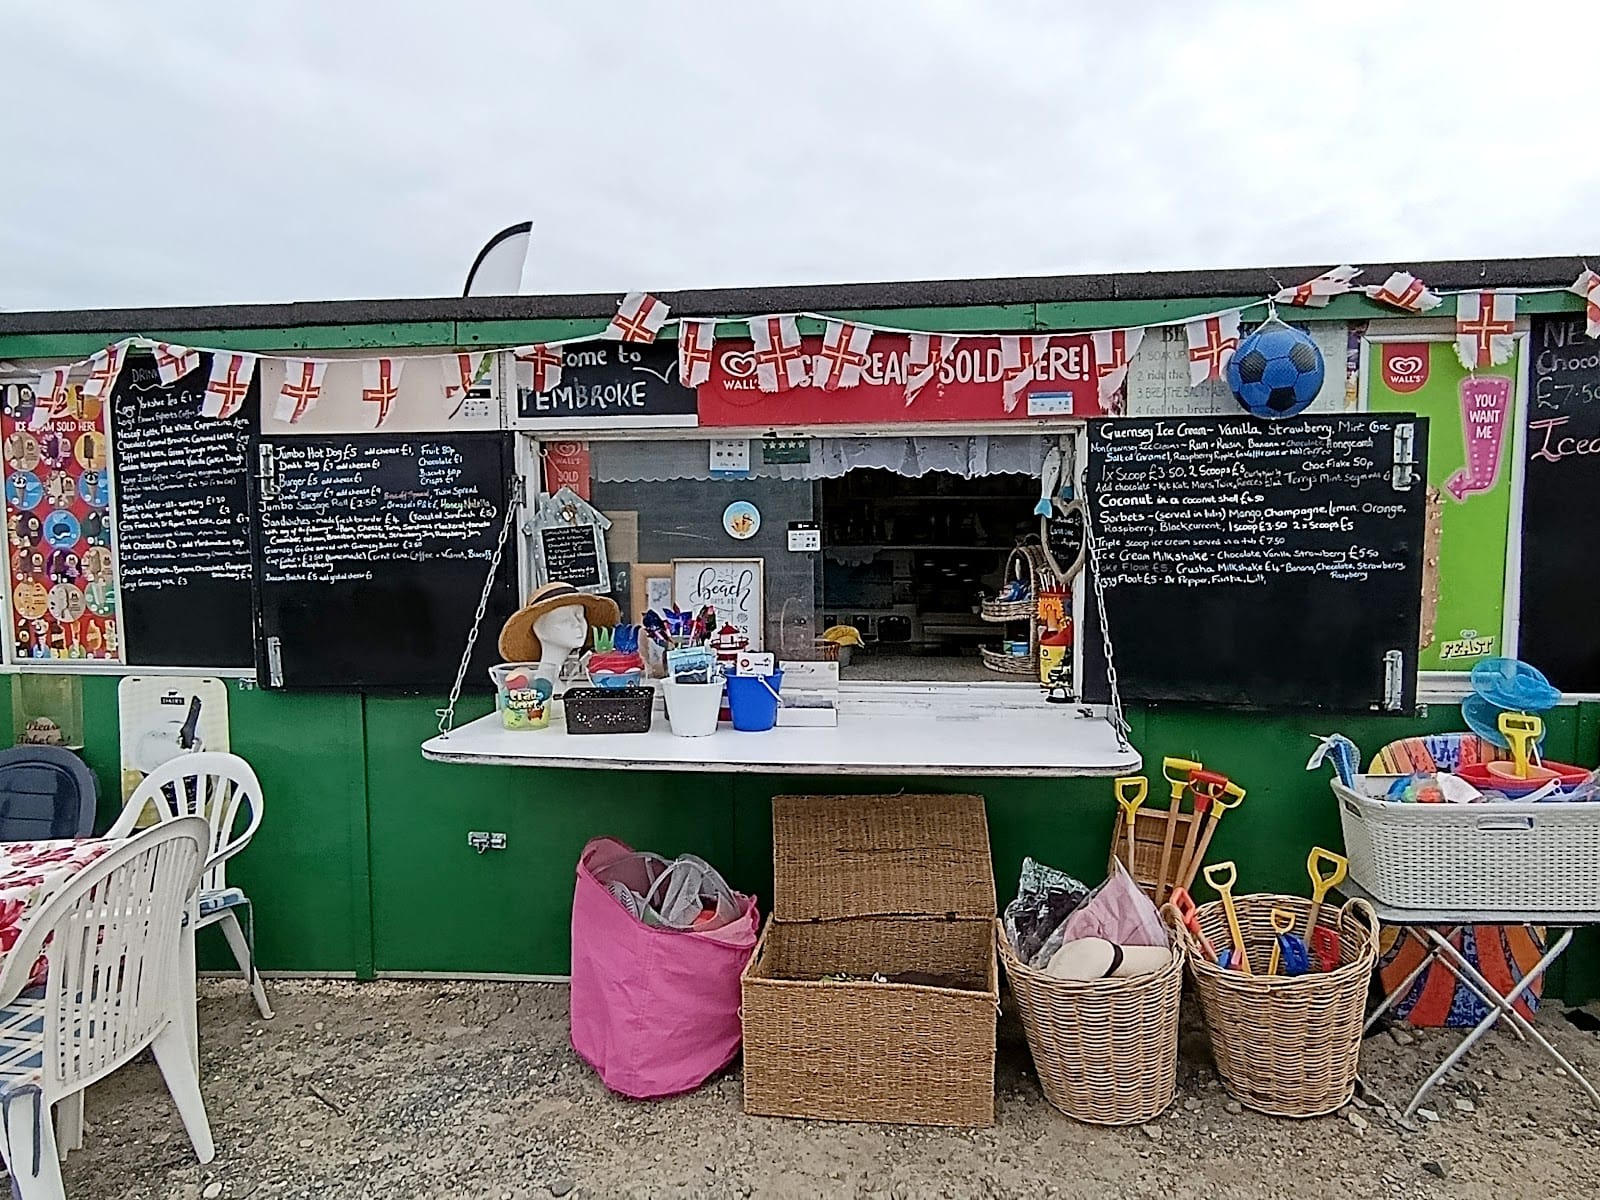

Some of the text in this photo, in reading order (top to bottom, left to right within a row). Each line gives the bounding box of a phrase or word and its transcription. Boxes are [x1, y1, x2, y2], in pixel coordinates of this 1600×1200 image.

[618, 345, 641, 363] to
[940, 349, 1004, 384] SOLD
[1390, 375, 1422, 384] WALL'S
[1474, 394, 1496, 408] YOU
[1469, 410, 1500, 424] WANT
[15, 422, 26, 432] ICE
[56, 422, 76, 432] SOLD
[78, 422, 96, 432] HERE
[1100, 422, 1154, 444] Guernsey
[1155, 422, 1174, 436] Ice
[1218, 422, 1262, 436] Vanilla
[1338, 420, 1365, 432] Mint
[1369, 420, 1392, 434] Choc
[1476, 426, 1492, 439] ME
[274, 446, 305, 460] Jumbo
[307, 446, 324, 460] Hot
[326, 448, 342, 462] Dog
[343, 444, 358, 460] £5
[421, 444, 440, 455] Fruit
[1091, 442, 1106, 452] Non
[1106, 442, 1138, 456] Guernsey
[1188, 439, 1208, 450] Rum
[1248, 438, 1280, 448] Banana
[418, 457, 452, 466] Chocolate
[1104, 452, 1133, 462] Salted
[1174, 452, 1213, 464] Raspberry
[1353, 456, 1374, 470] 50p
[304, 461, 320, 471] Dog
[1116, 467, 1146, 481] Scoop
[1189, 464, 1198, 478] 2
[1199, 464, 1231, 478] Scoops
[1232, 461, 1246, 476] £5
[278, 473, 306, 493] Burger
[308, 472, 318, 486] £5
[420, 477, 443, 486] Crisps
[558, 471, 579, 482] SOLD
[1095, 482, 1112, 493] Add
[1115, 482, 1150, 492] chocolate
[258, 500, 294, 512] Jumbo
[332, 498, 348, 506] Roll
[350, 496, 377, 510] £2.50
[1098, 494, 1154, 508] Coconut
[1156, 494, 1168, 504] in
[1170, 496, 1180, 505] a
[1182, 496, 1217, 504] coconut
[1218, 494, 1238, 504] shell
[385, 512, 400, 524] £4
[1099, 510, 1145, 524] Sorbets
[1194, 510, 1202, 518] in
[1233, 523, 1258, 534] scoop
[1259, 521, 1288, 532] £3.50
[1292, 522, 1300, 530] 2
[1340, 516, 1354, 532] £5
[1096, 536, 1120, 550] Triple
[1124, 540, 1150, 550] scoop
[1193, 538, 1220, 546] served
[468, 549, 492, 560] Biscoff
[1093, 548, 1116, 560] Ice
[1119, 548, 1150, 562] Cream
[1152, 551, 1208, 562] Milkshake
[1293, 550, 1346, 562] Strawberry
[1121, 562, 1150, 572] Float
[1176, 562, 1215, 574] Crusha
[1218, 562, 1263, 572] Milkshake
[1264, 560, 1280, 572] £4
[1118, 572, 1175, 584] Float £5 Dr
[1330, 570, 1368, 581] Raspberry
[690, 567, 752, 612] beach
[1440, 636, 1494, 660] FEAST
